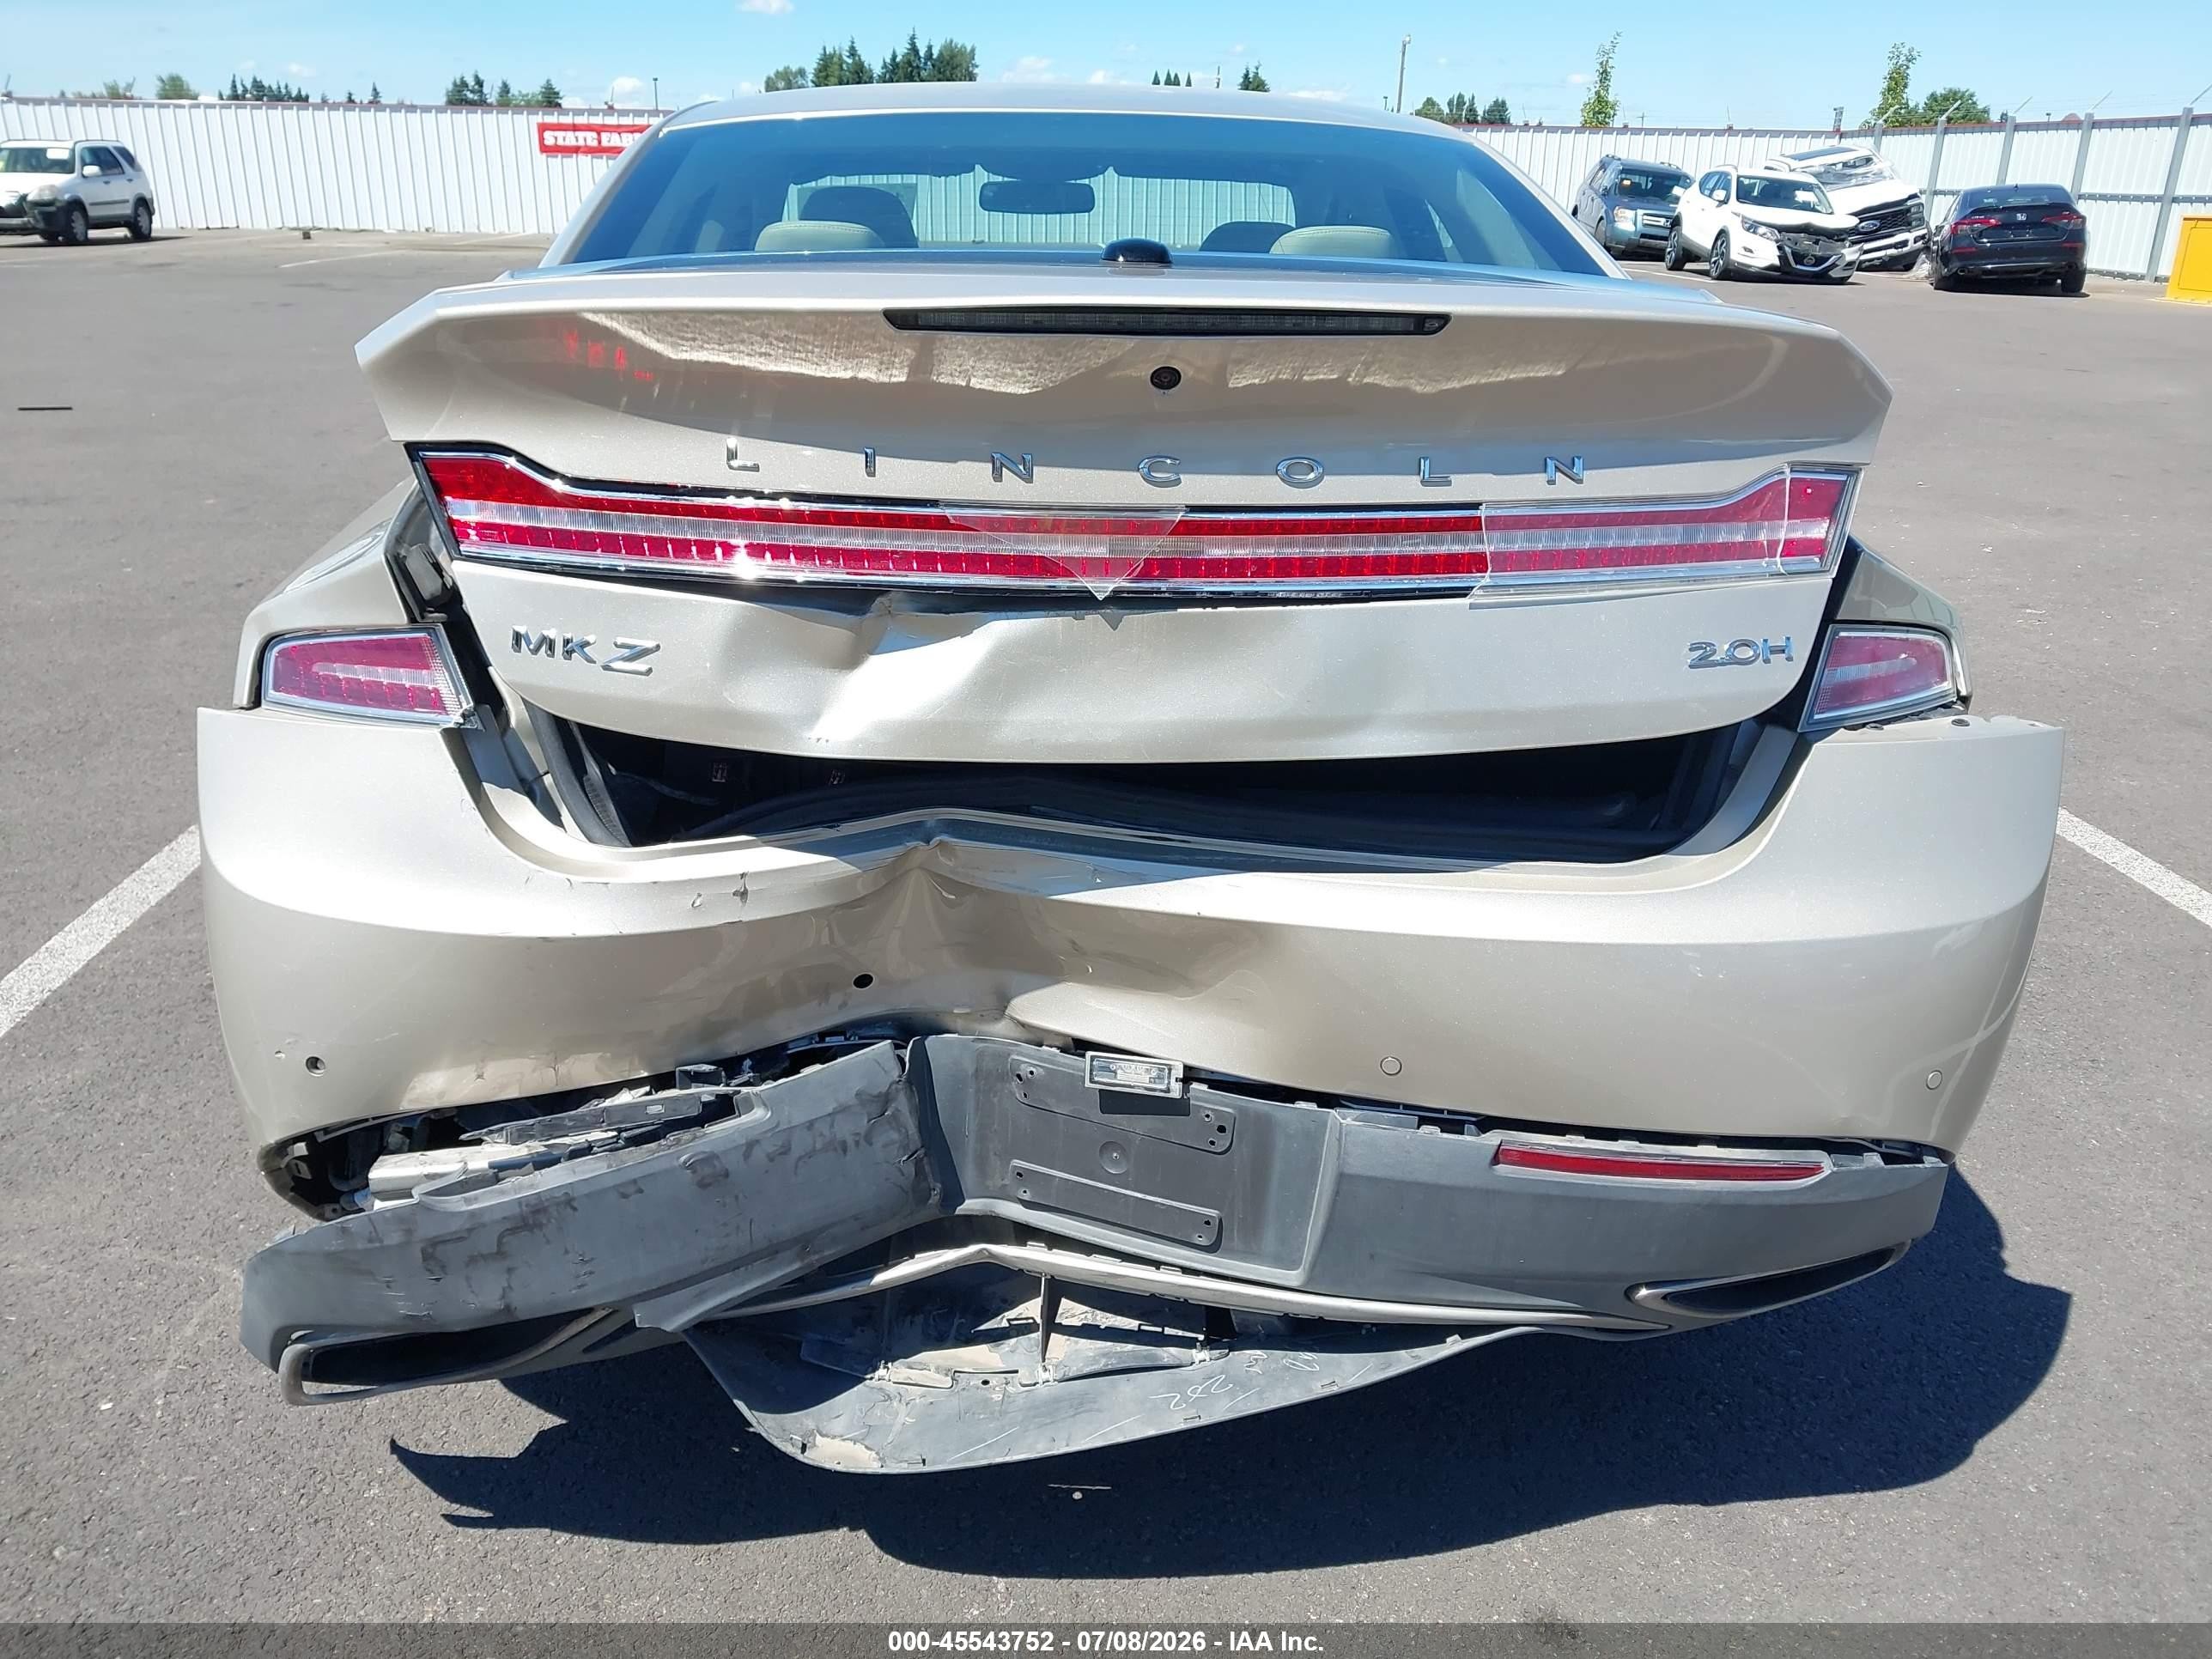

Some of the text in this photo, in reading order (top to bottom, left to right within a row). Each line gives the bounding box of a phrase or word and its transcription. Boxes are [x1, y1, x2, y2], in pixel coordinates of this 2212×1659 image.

[543, 130, 641, 147] STATE FAR
[726, 437, 1586, 488] LINCOLN
[510, 624, 661, 677] MKZ
